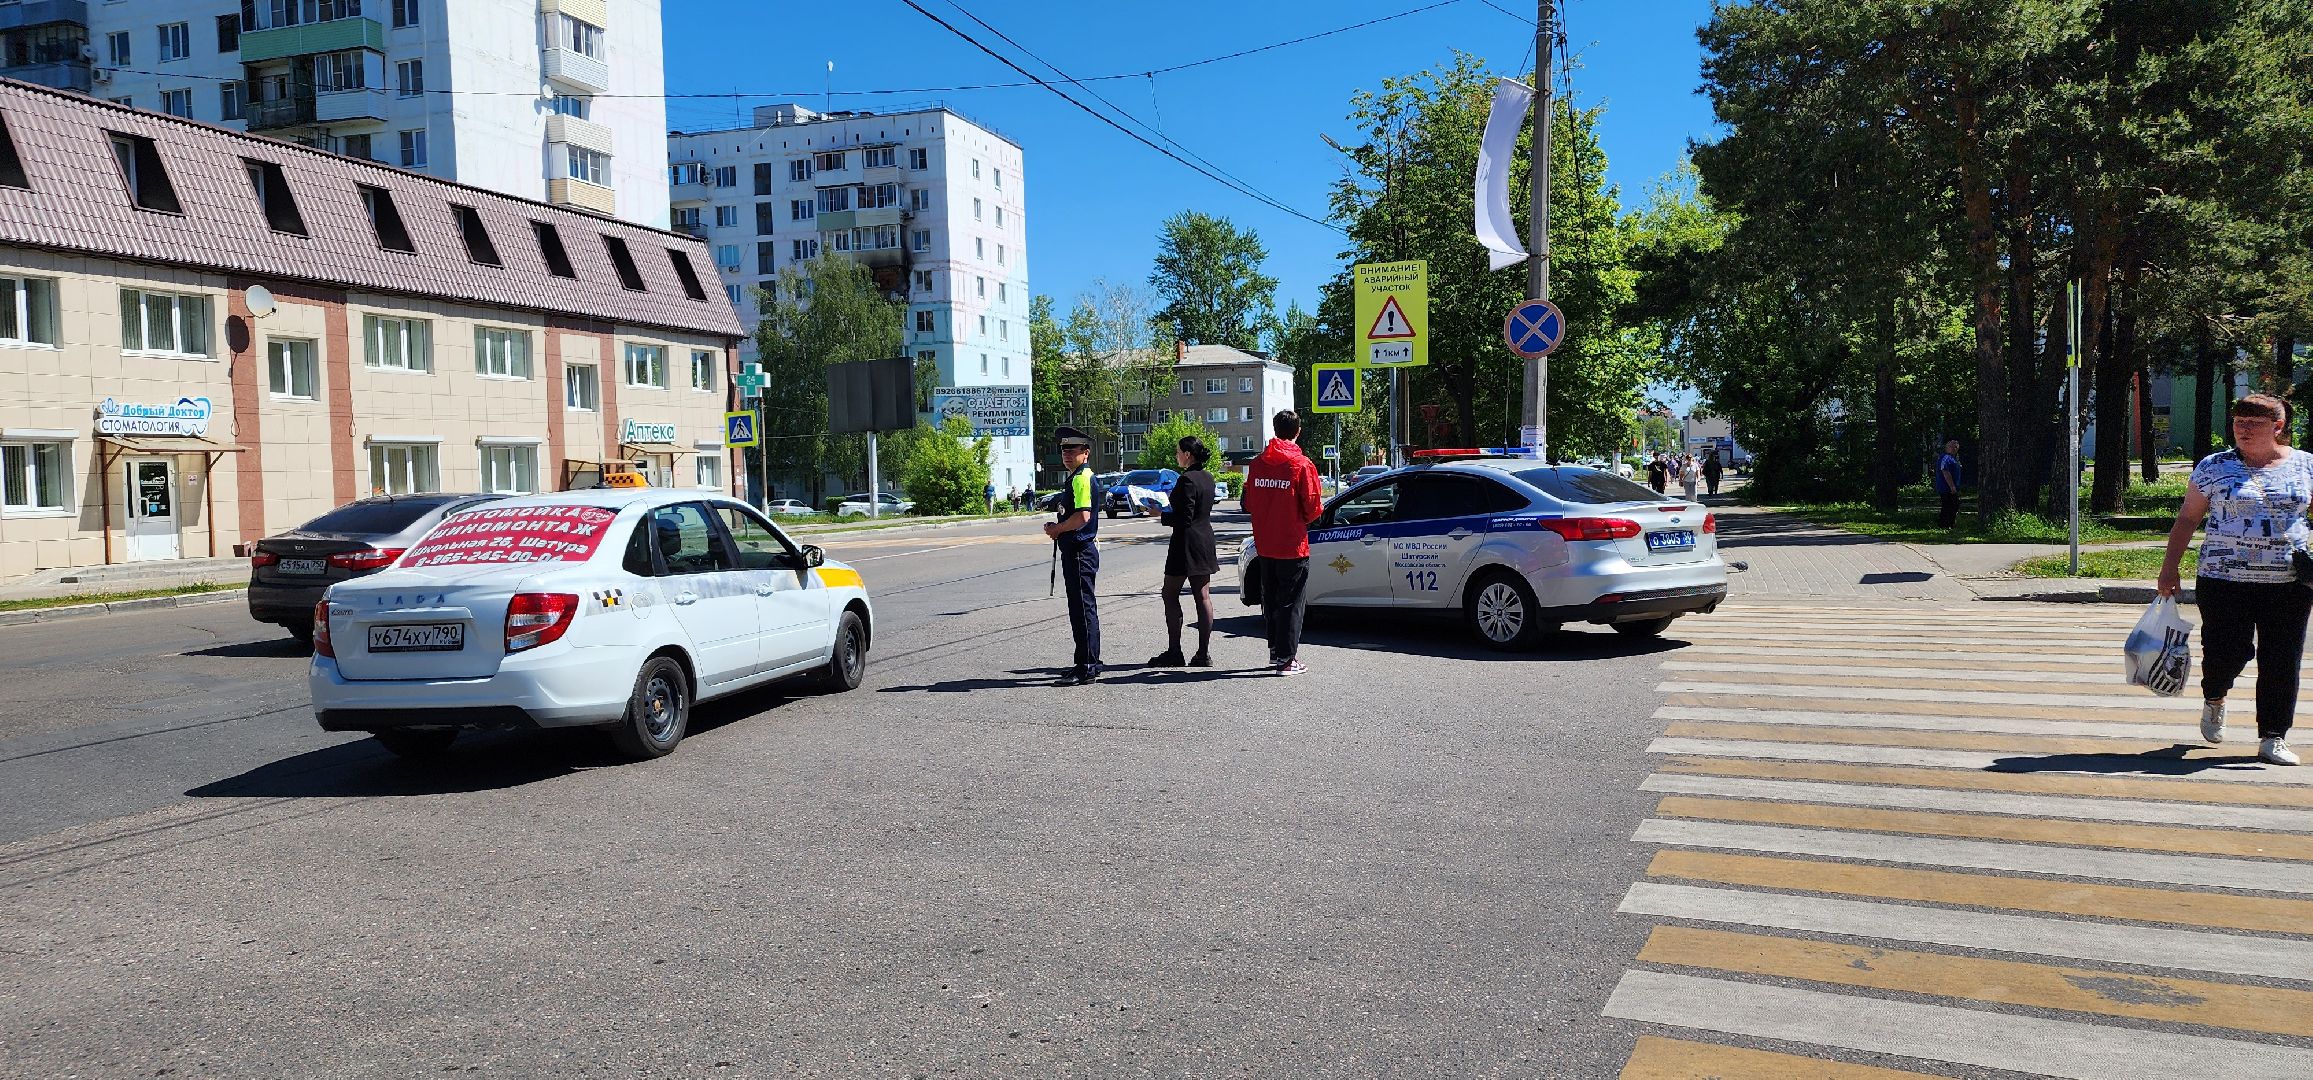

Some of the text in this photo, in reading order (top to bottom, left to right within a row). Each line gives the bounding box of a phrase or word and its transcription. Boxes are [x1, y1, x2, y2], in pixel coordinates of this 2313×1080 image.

[1360, 264, 1421, 274] ВНИМАНИЕ!
[1363, 272, 1419, 284] АВАРИЙНЫЙ
[1371, 283, 1411, 293] УЧАСТОК
[967, 396, 1028, 410] СДАЕТСЯ
[122, 404, 205, 418] Добрый Доктор
[972, 409, 1027, 418] РЕКЛАМНОЕ
[101, 420, 180, 432] СТОМАТОЛОГИЯ
[627, 420, 675, 440] Аптека
[443, 506, 581, 526] АВТОМОЙКА
[427, 519, 599, 542] ШИНОМОНТАЖ
[1318, 529, 1362, 541] ПОЛИЦИЯ
[518, 536, 589, 555] Шатура
[1405, 570, 1439, 591] 112
[377, 593, 445, 605] LADA
[433, 626, 458, 640] 790
